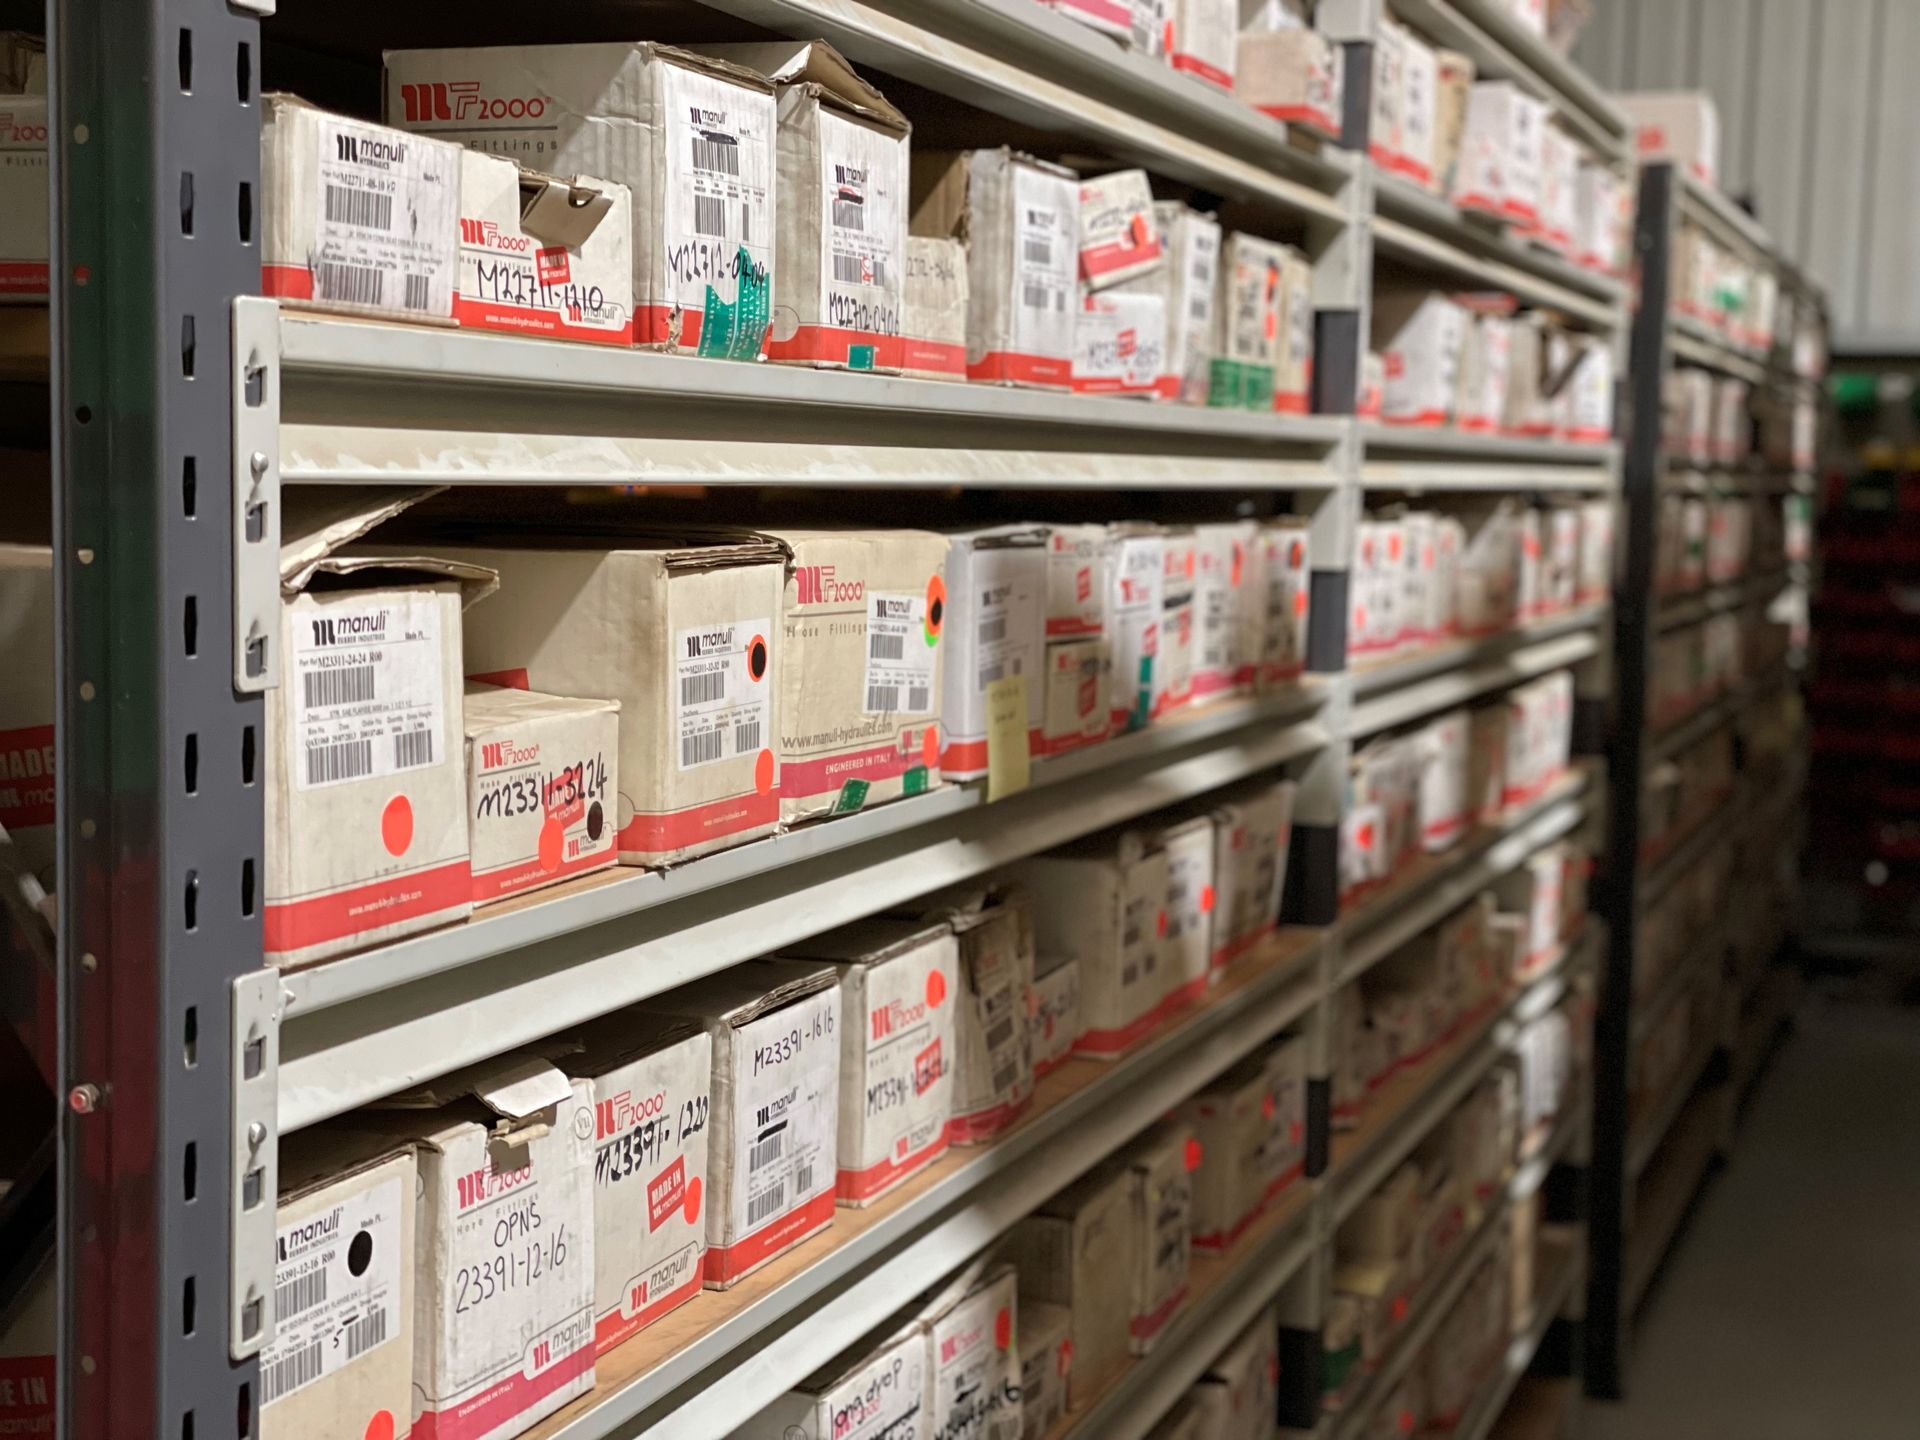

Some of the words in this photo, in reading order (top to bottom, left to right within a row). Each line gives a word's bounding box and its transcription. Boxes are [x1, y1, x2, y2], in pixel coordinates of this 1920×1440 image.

[361, 139, 405, 164] manuli
[338, 611, 386, 635] manuli
[702, 630, 732, 647] manuli
[825, 758, 864, 775] ENGINEERED
[865, 756, 873, 767] IN
[874, 752, 891, 764] ITALY
[652, 1177, 672, 1206] MADE
[673, 1167, 681, 1187] IN
[289, 1209, 340, 1249] manuli
[494, 1202, 541, 1247] OPNS
[456, 1224, 566, 1314] 23391-12-16
[650, 1251, 689, 1289] manuli
[552, 1310, 592, 1350] manuli
[865, 1358, 903, 1402] drop
